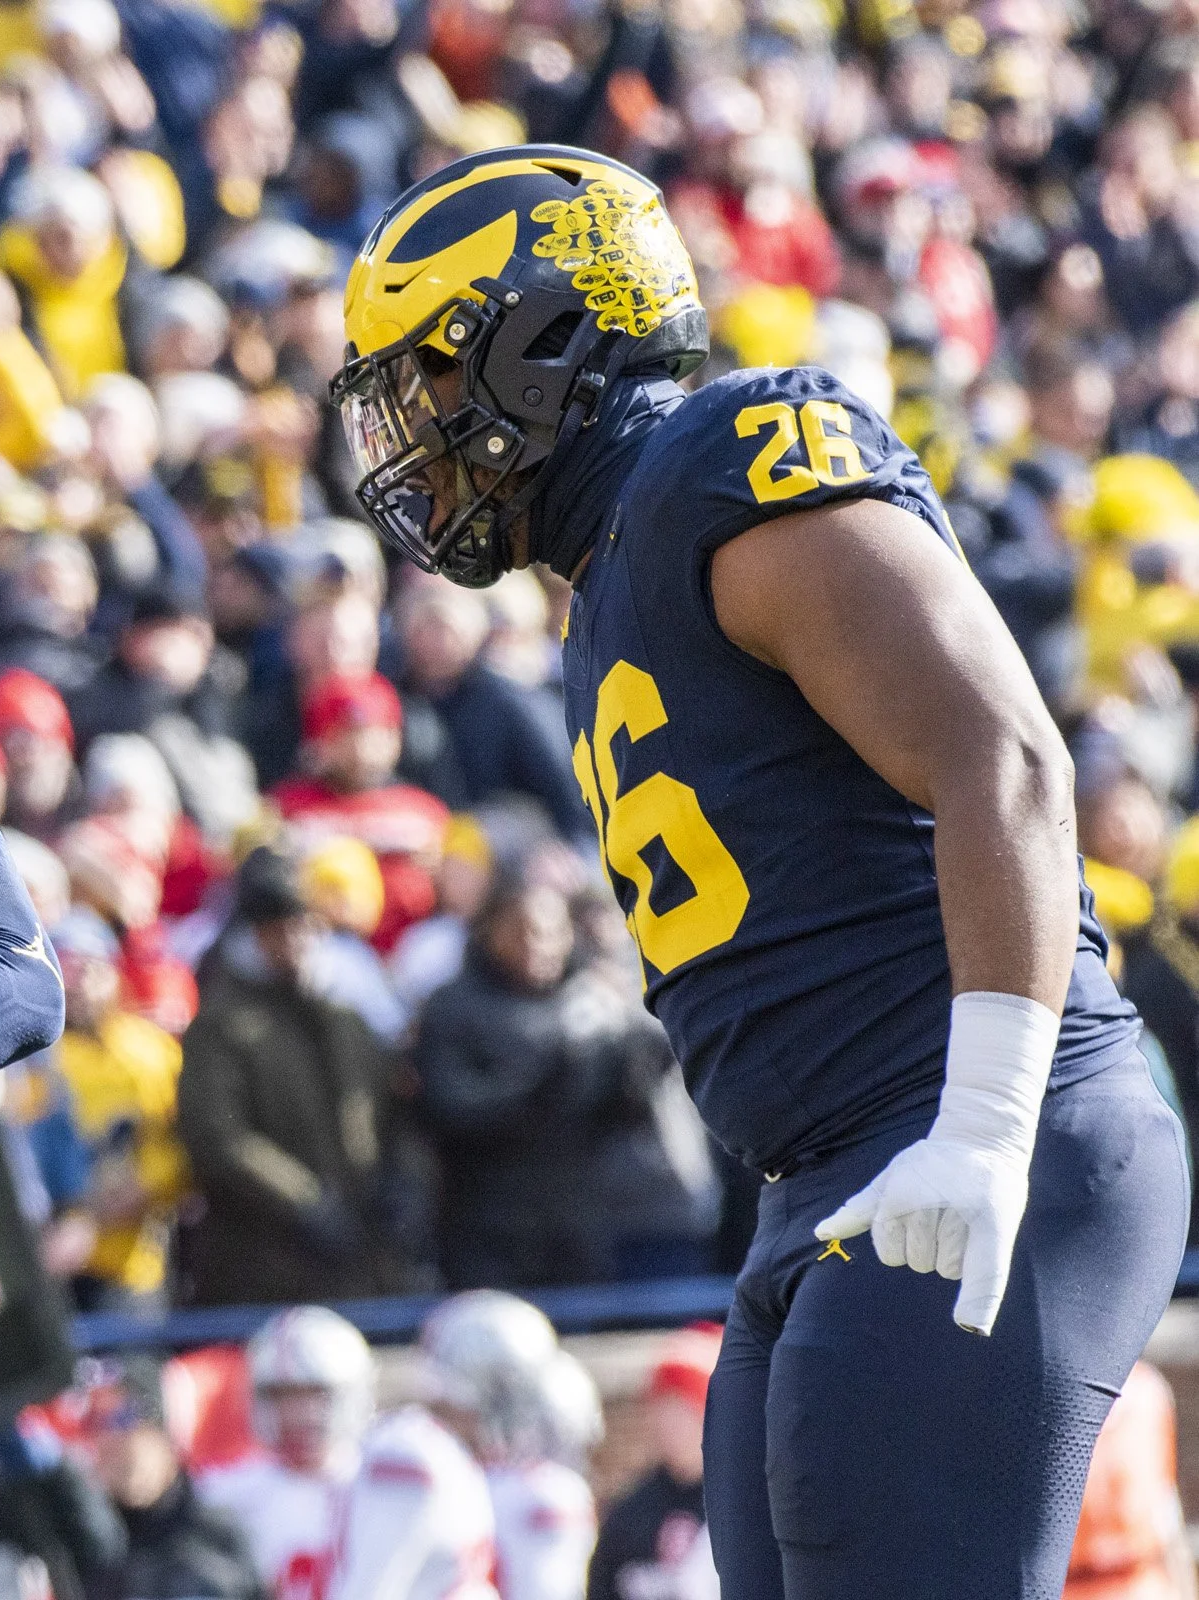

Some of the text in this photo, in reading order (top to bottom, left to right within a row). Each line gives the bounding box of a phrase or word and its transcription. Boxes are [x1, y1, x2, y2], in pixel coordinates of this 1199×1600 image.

[600, 250, 624, 264] TED
[591, 290, 617, 306] TED
[734, 400, 875, 504] 26
